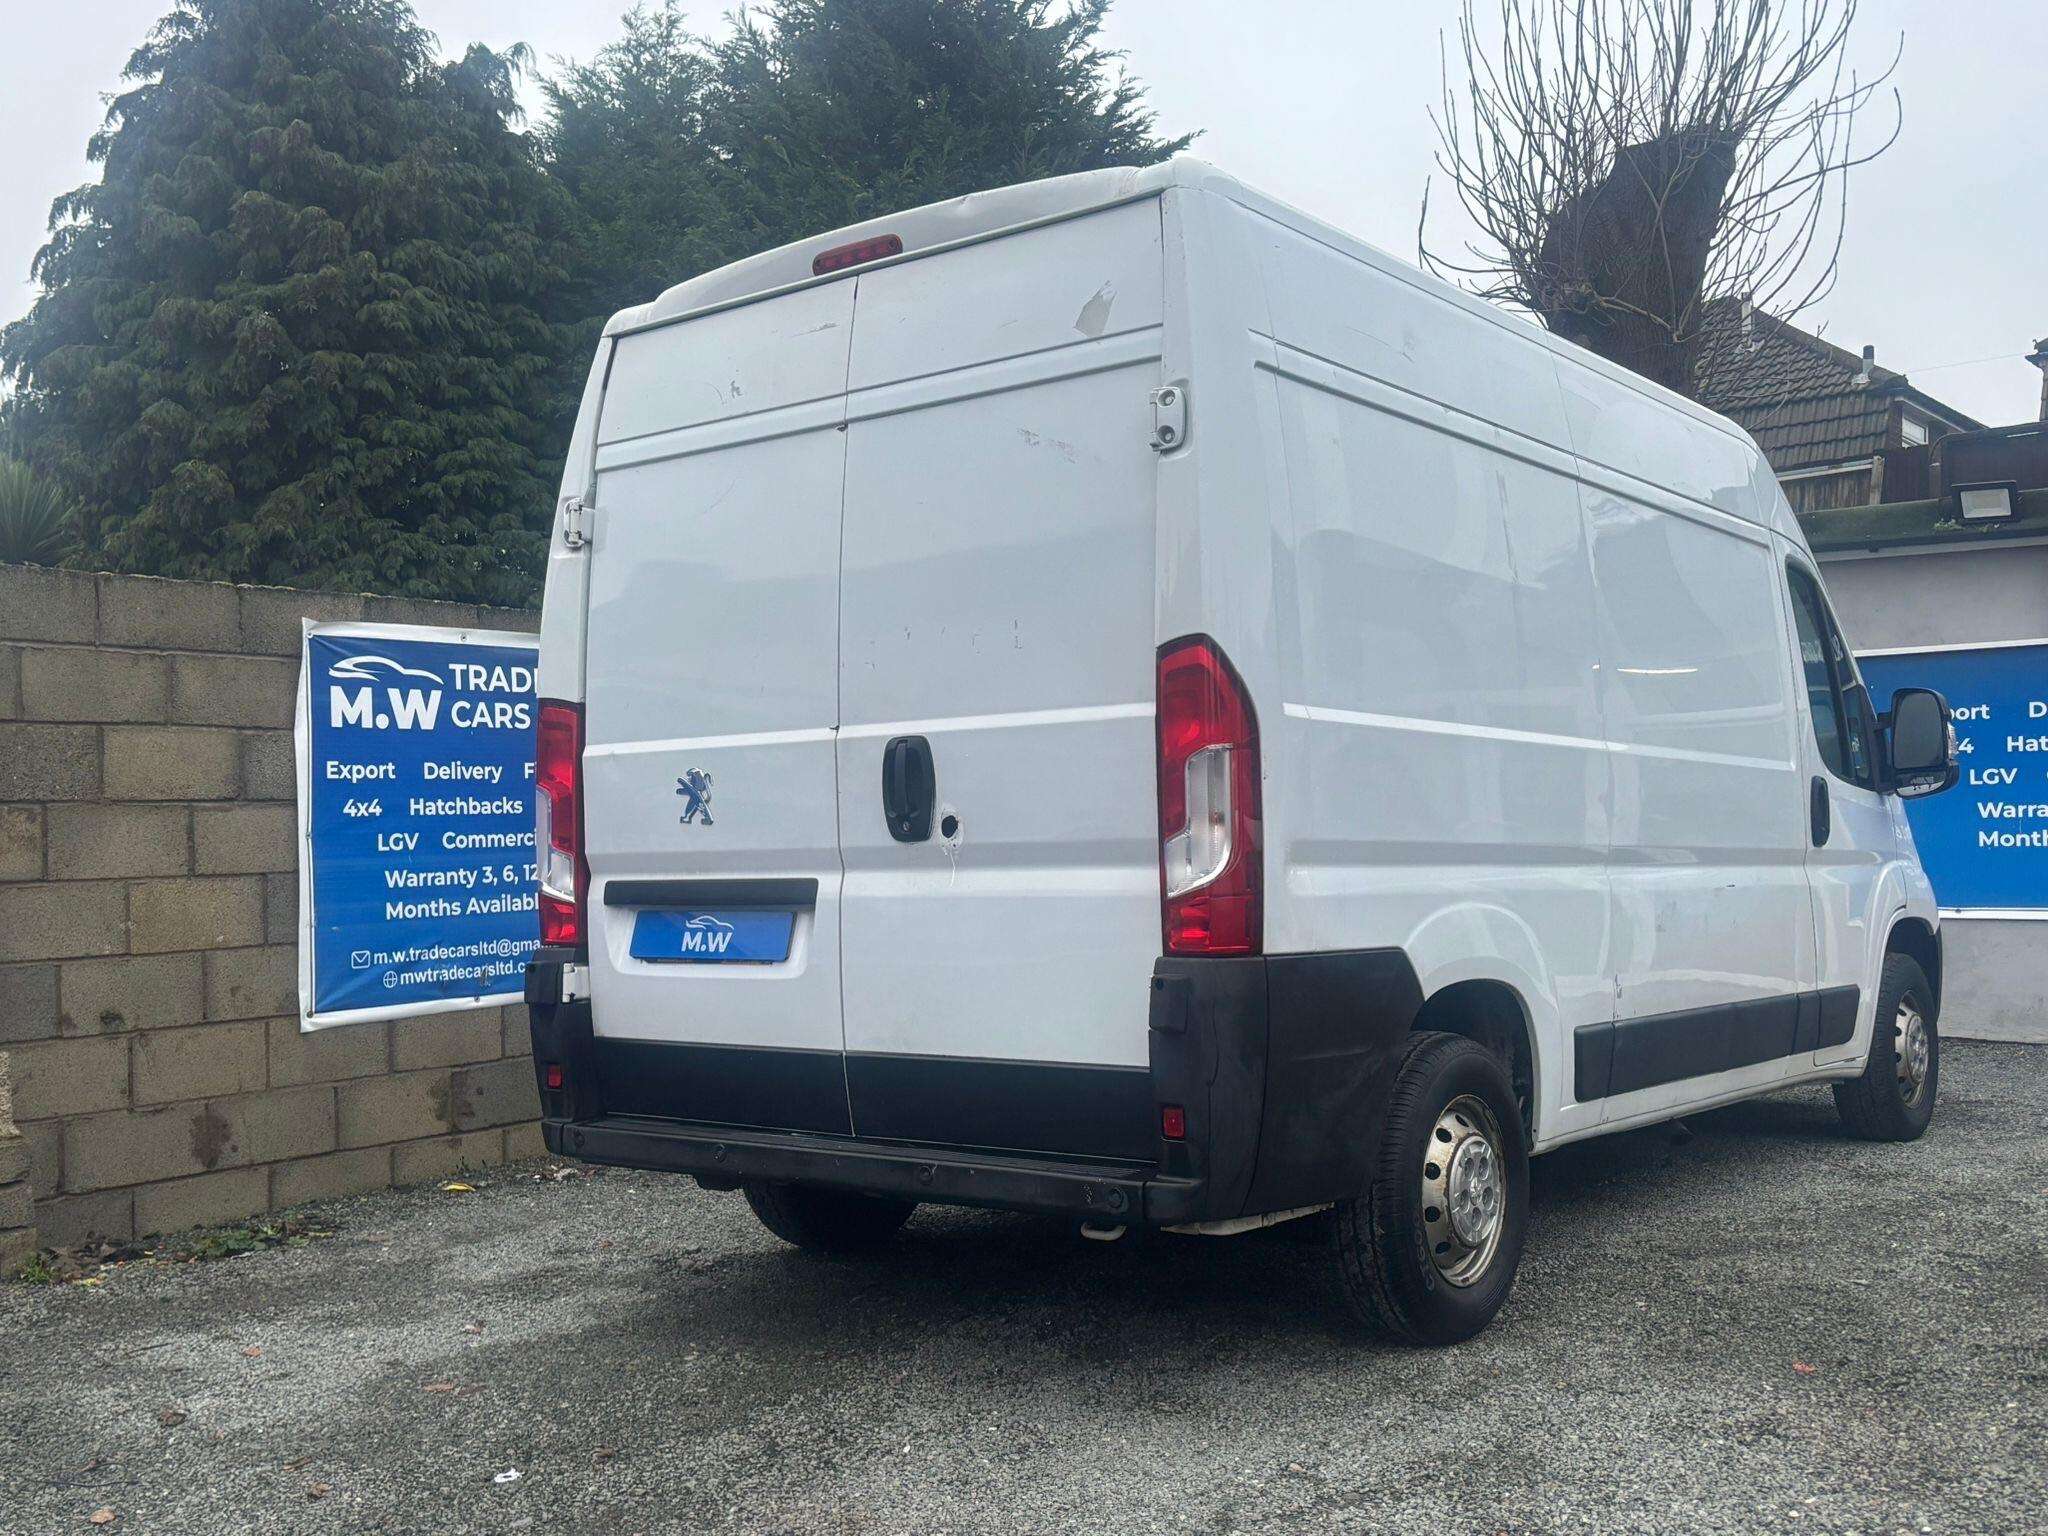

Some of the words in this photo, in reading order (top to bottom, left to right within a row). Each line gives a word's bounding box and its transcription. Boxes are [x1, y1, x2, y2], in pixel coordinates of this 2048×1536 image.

[449, 663, 538, 693] TRAD
[330, 685, 442, 730] M.W
[452, 701, 530, 729] CARS
[1950, 705, 1990, 720] ort
[327, 761, 395, 783] Export
[424, 761, 502, 783] Delivery
[1970, 768, 2017, 784] LGV
[343, 799, 382, 816] 4x4
[410, 797, 522, 815] Hatchbacks
[1978, 803, 2048, 818] Warra
[378, 833, 419, 851] LGV
[443, 828, 536, 849] Commerci
[385, 869, 477, 888] Warranty
[483, 867, 497, 885] 3,
[503, 865, 518, 884] 6,
[523, 864, 538, 881] 12
[386, 899, 461, 919] Months
[466, 893, 539, 914] Availabl
[374, 938, 541, 964] m.w.tradecarsltd@gma
[682, 932, 732, 952] M.W
[400, 959, 526, 984] mwtradecarsltd.c
